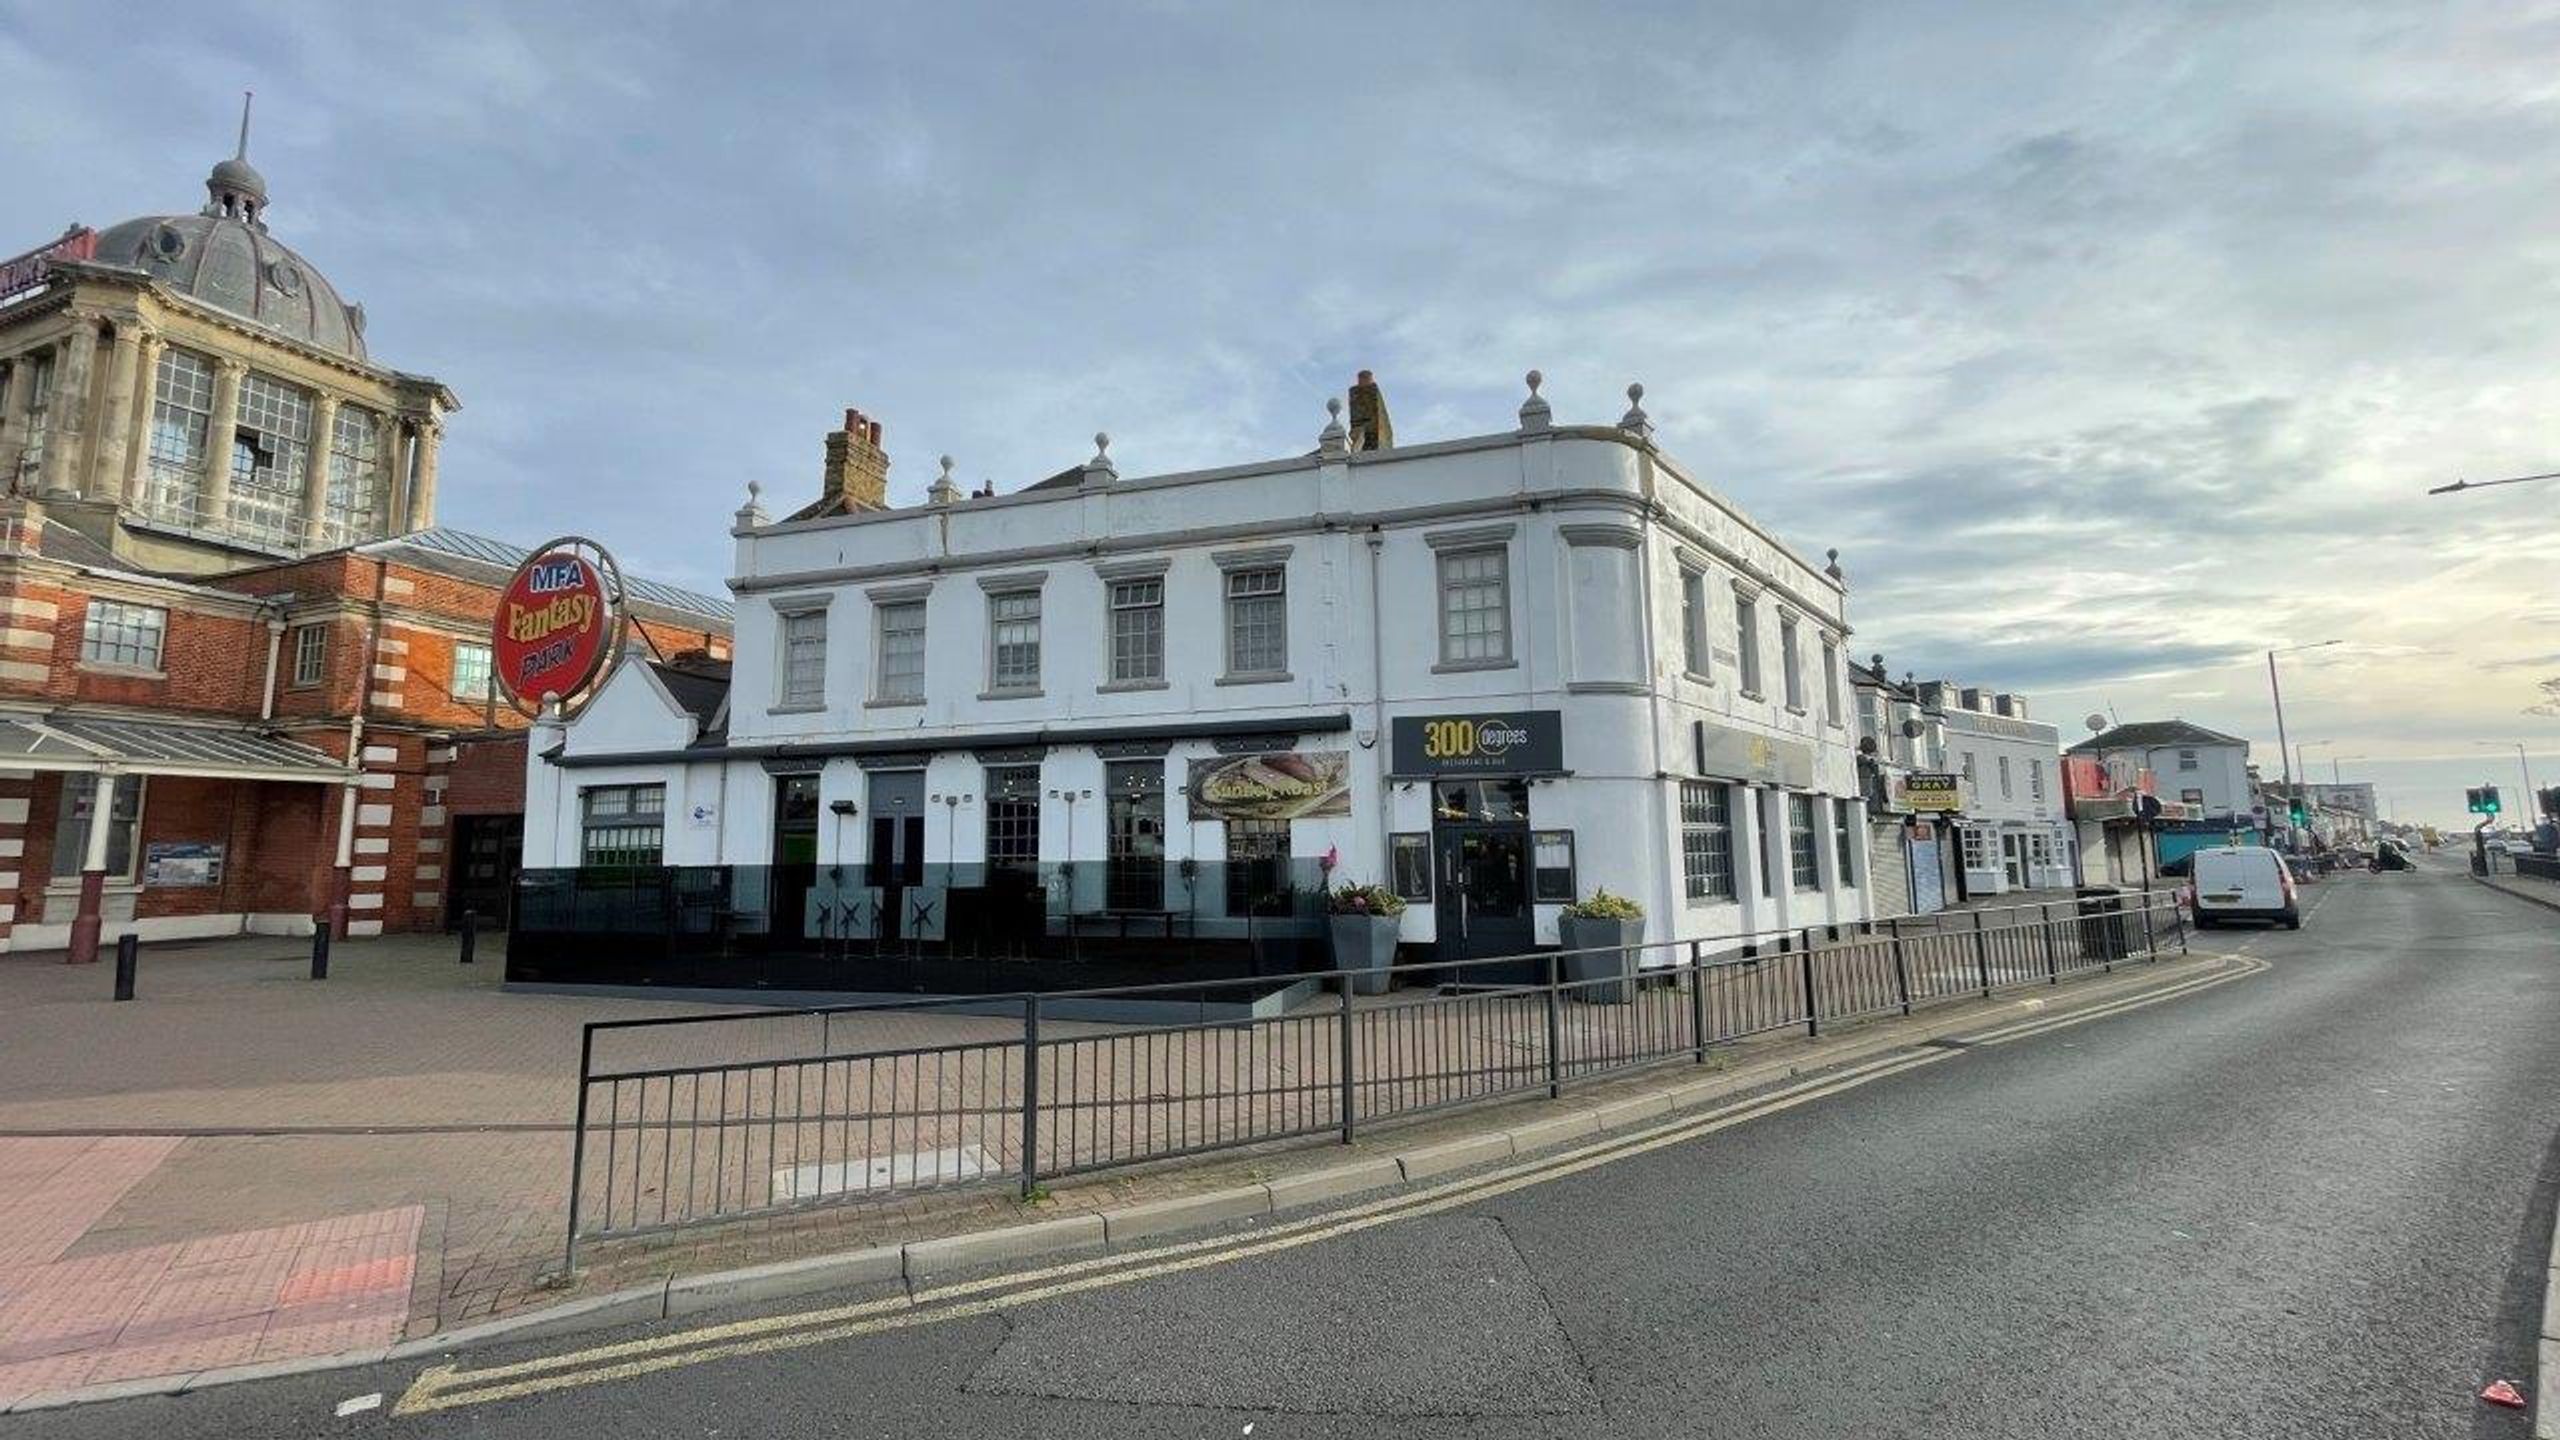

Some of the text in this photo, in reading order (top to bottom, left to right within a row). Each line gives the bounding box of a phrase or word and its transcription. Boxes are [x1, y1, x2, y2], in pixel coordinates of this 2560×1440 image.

[531, 560, 584, 592] MFA
[508, 594, 597, 641] Fantasy
[518, 634, 578, 685] PARK
[1424, 719, 1527, 757] 300 degrees
